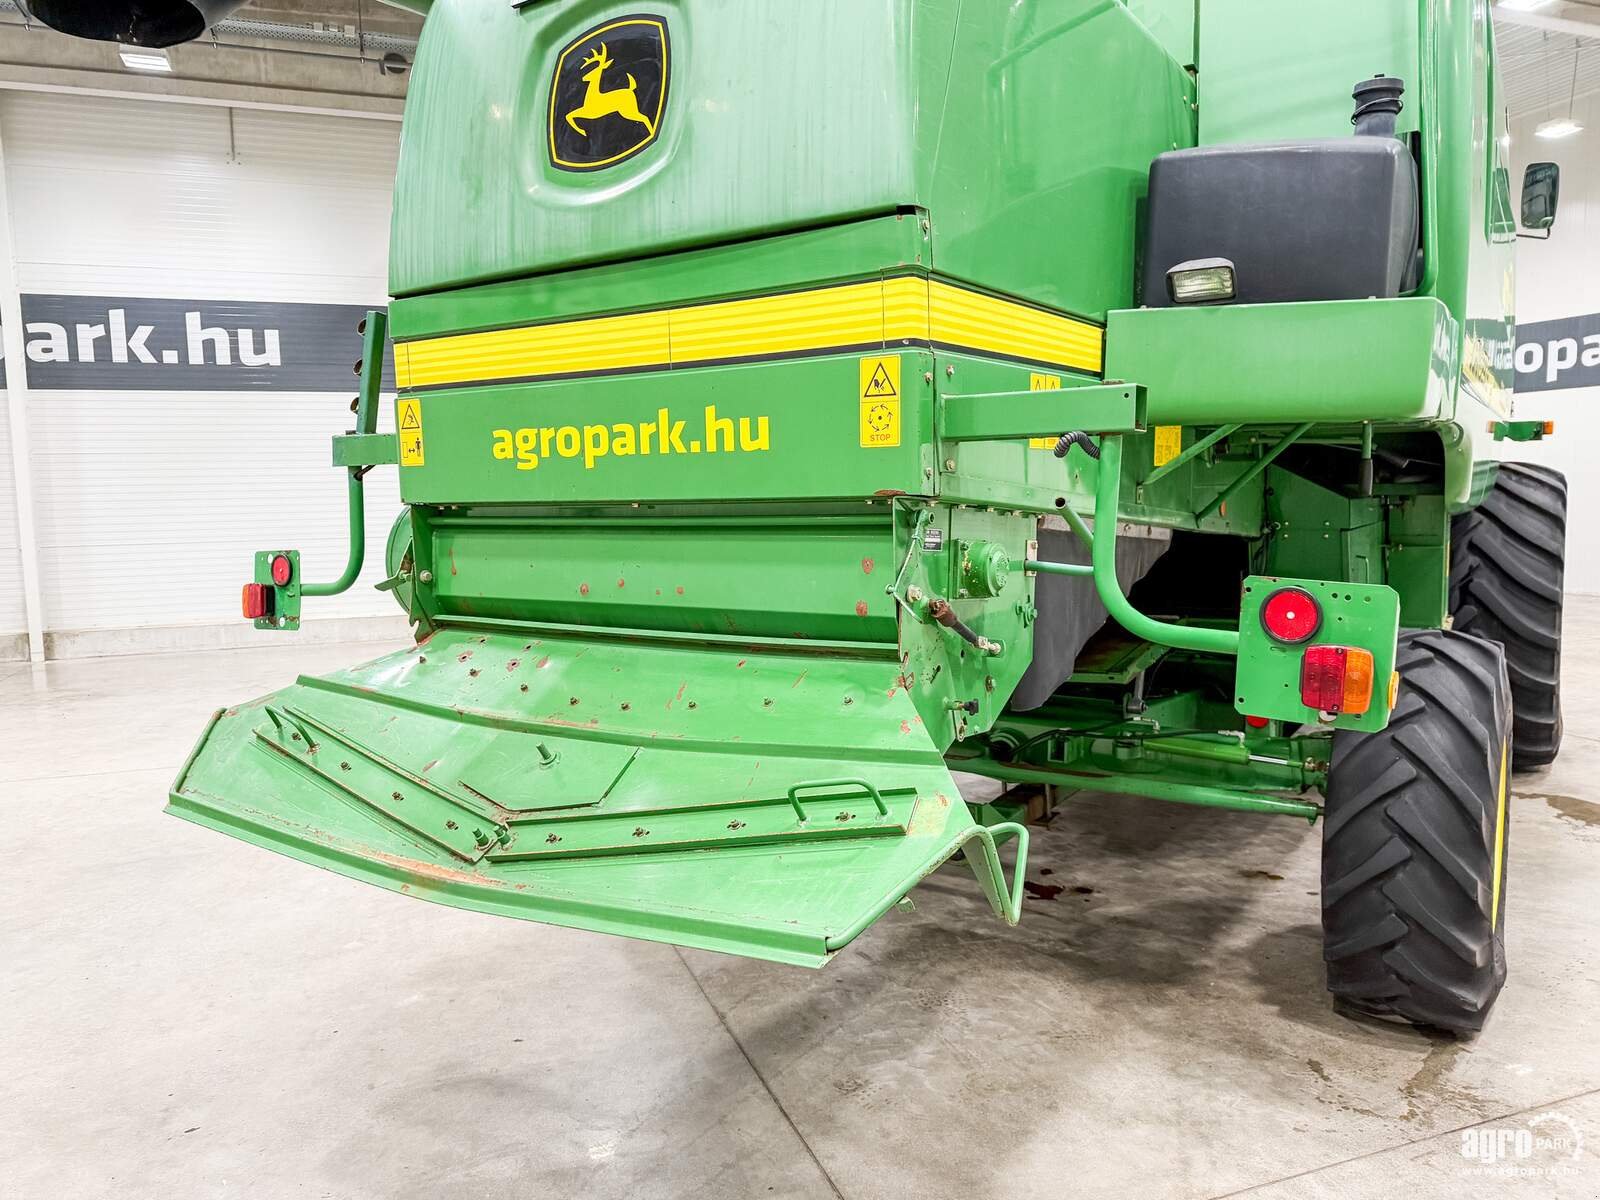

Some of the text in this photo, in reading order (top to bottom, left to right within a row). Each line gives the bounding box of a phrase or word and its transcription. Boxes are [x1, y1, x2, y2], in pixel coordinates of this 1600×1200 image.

[0, 308, 282, 367] ark.hu
[491, 405, 770, 470] agropark.hu
[870, 433, 891, 442] STOP
